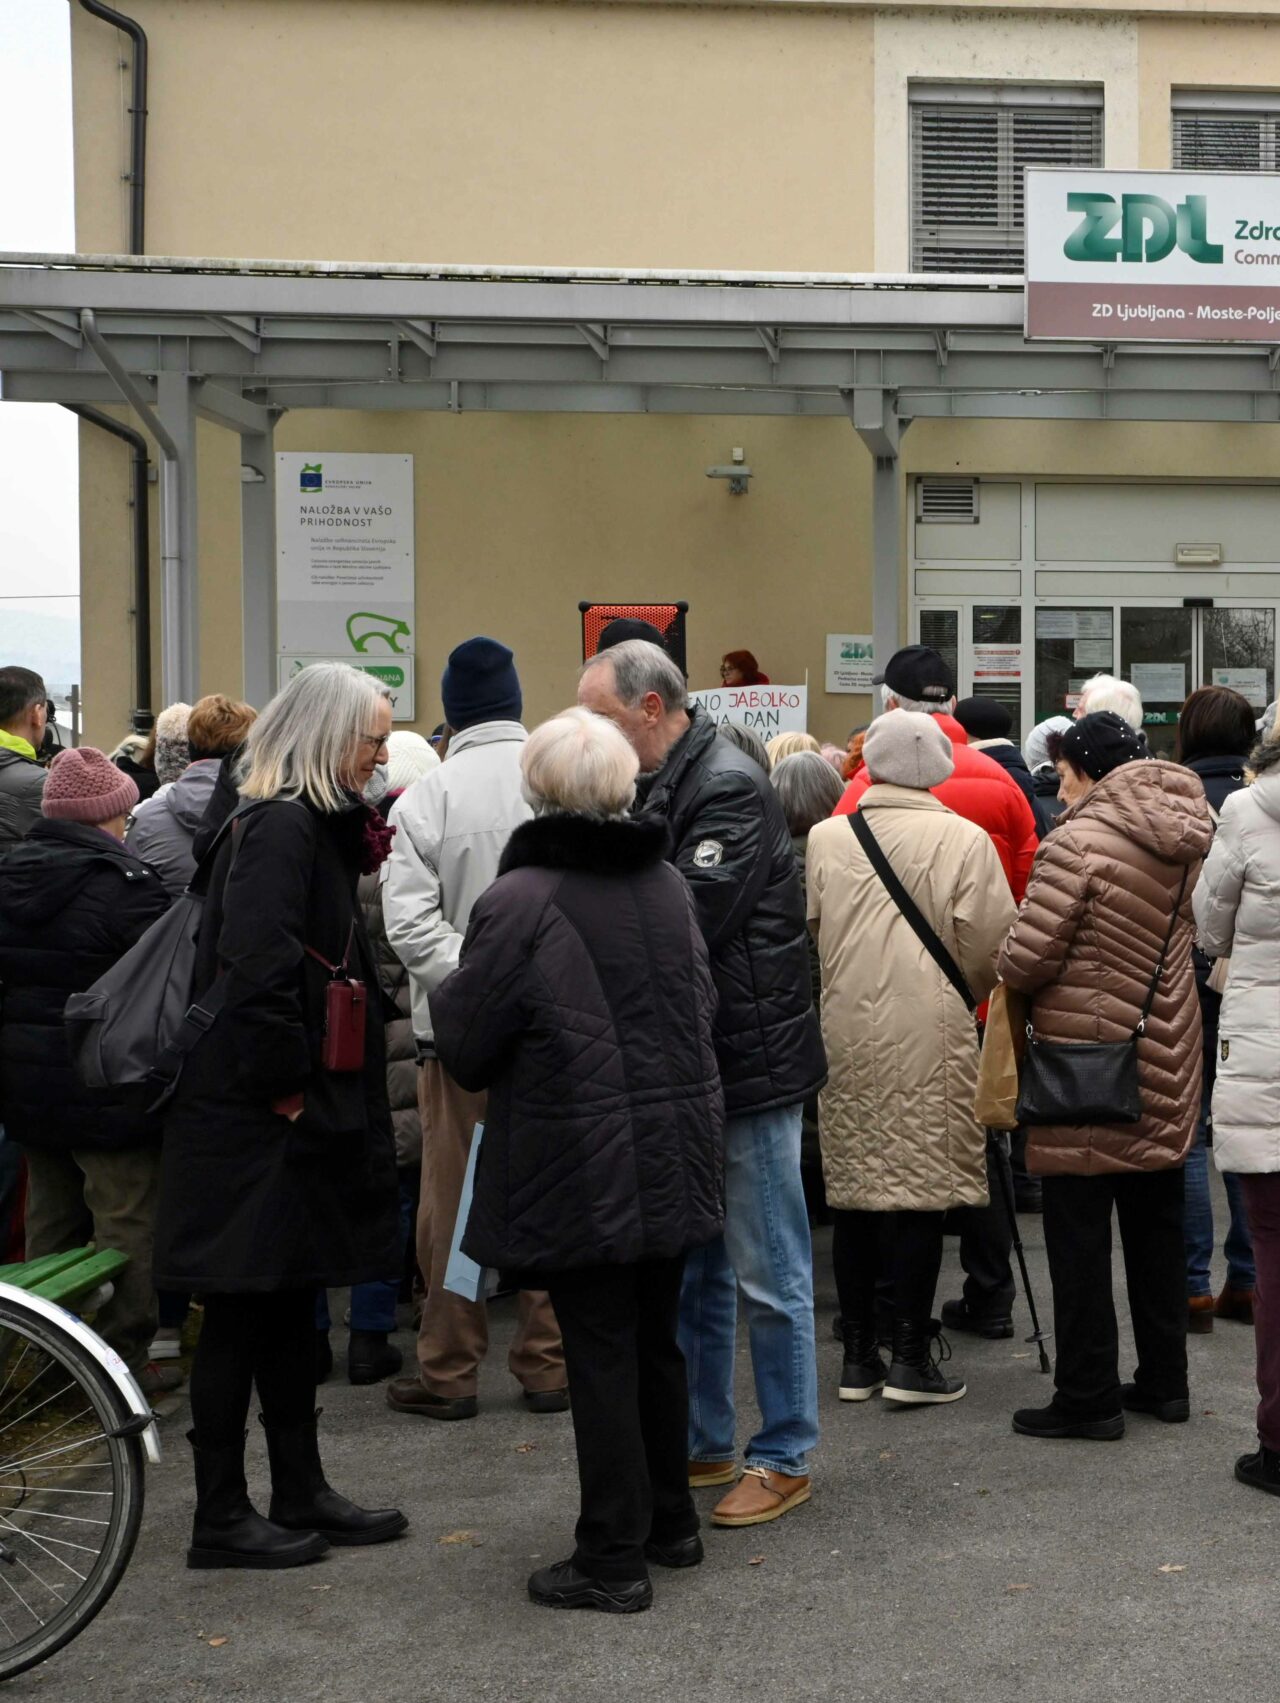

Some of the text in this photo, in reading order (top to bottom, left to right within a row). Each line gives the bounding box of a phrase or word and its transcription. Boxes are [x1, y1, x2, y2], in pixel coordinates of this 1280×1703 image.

[1063, 192, 1223, 264] ZDL
[1092, 304, 1113, 318] ZD
[1116, 304, 1186, 322] Ljubljana
[300, 504, 392, 516] NALOŽBA V VAŠO
[300, 517, 373, 527] PRIHODNOST
[728, 690, 800, 709] JABOLKO
[744, 709, 780, 728] DAN
